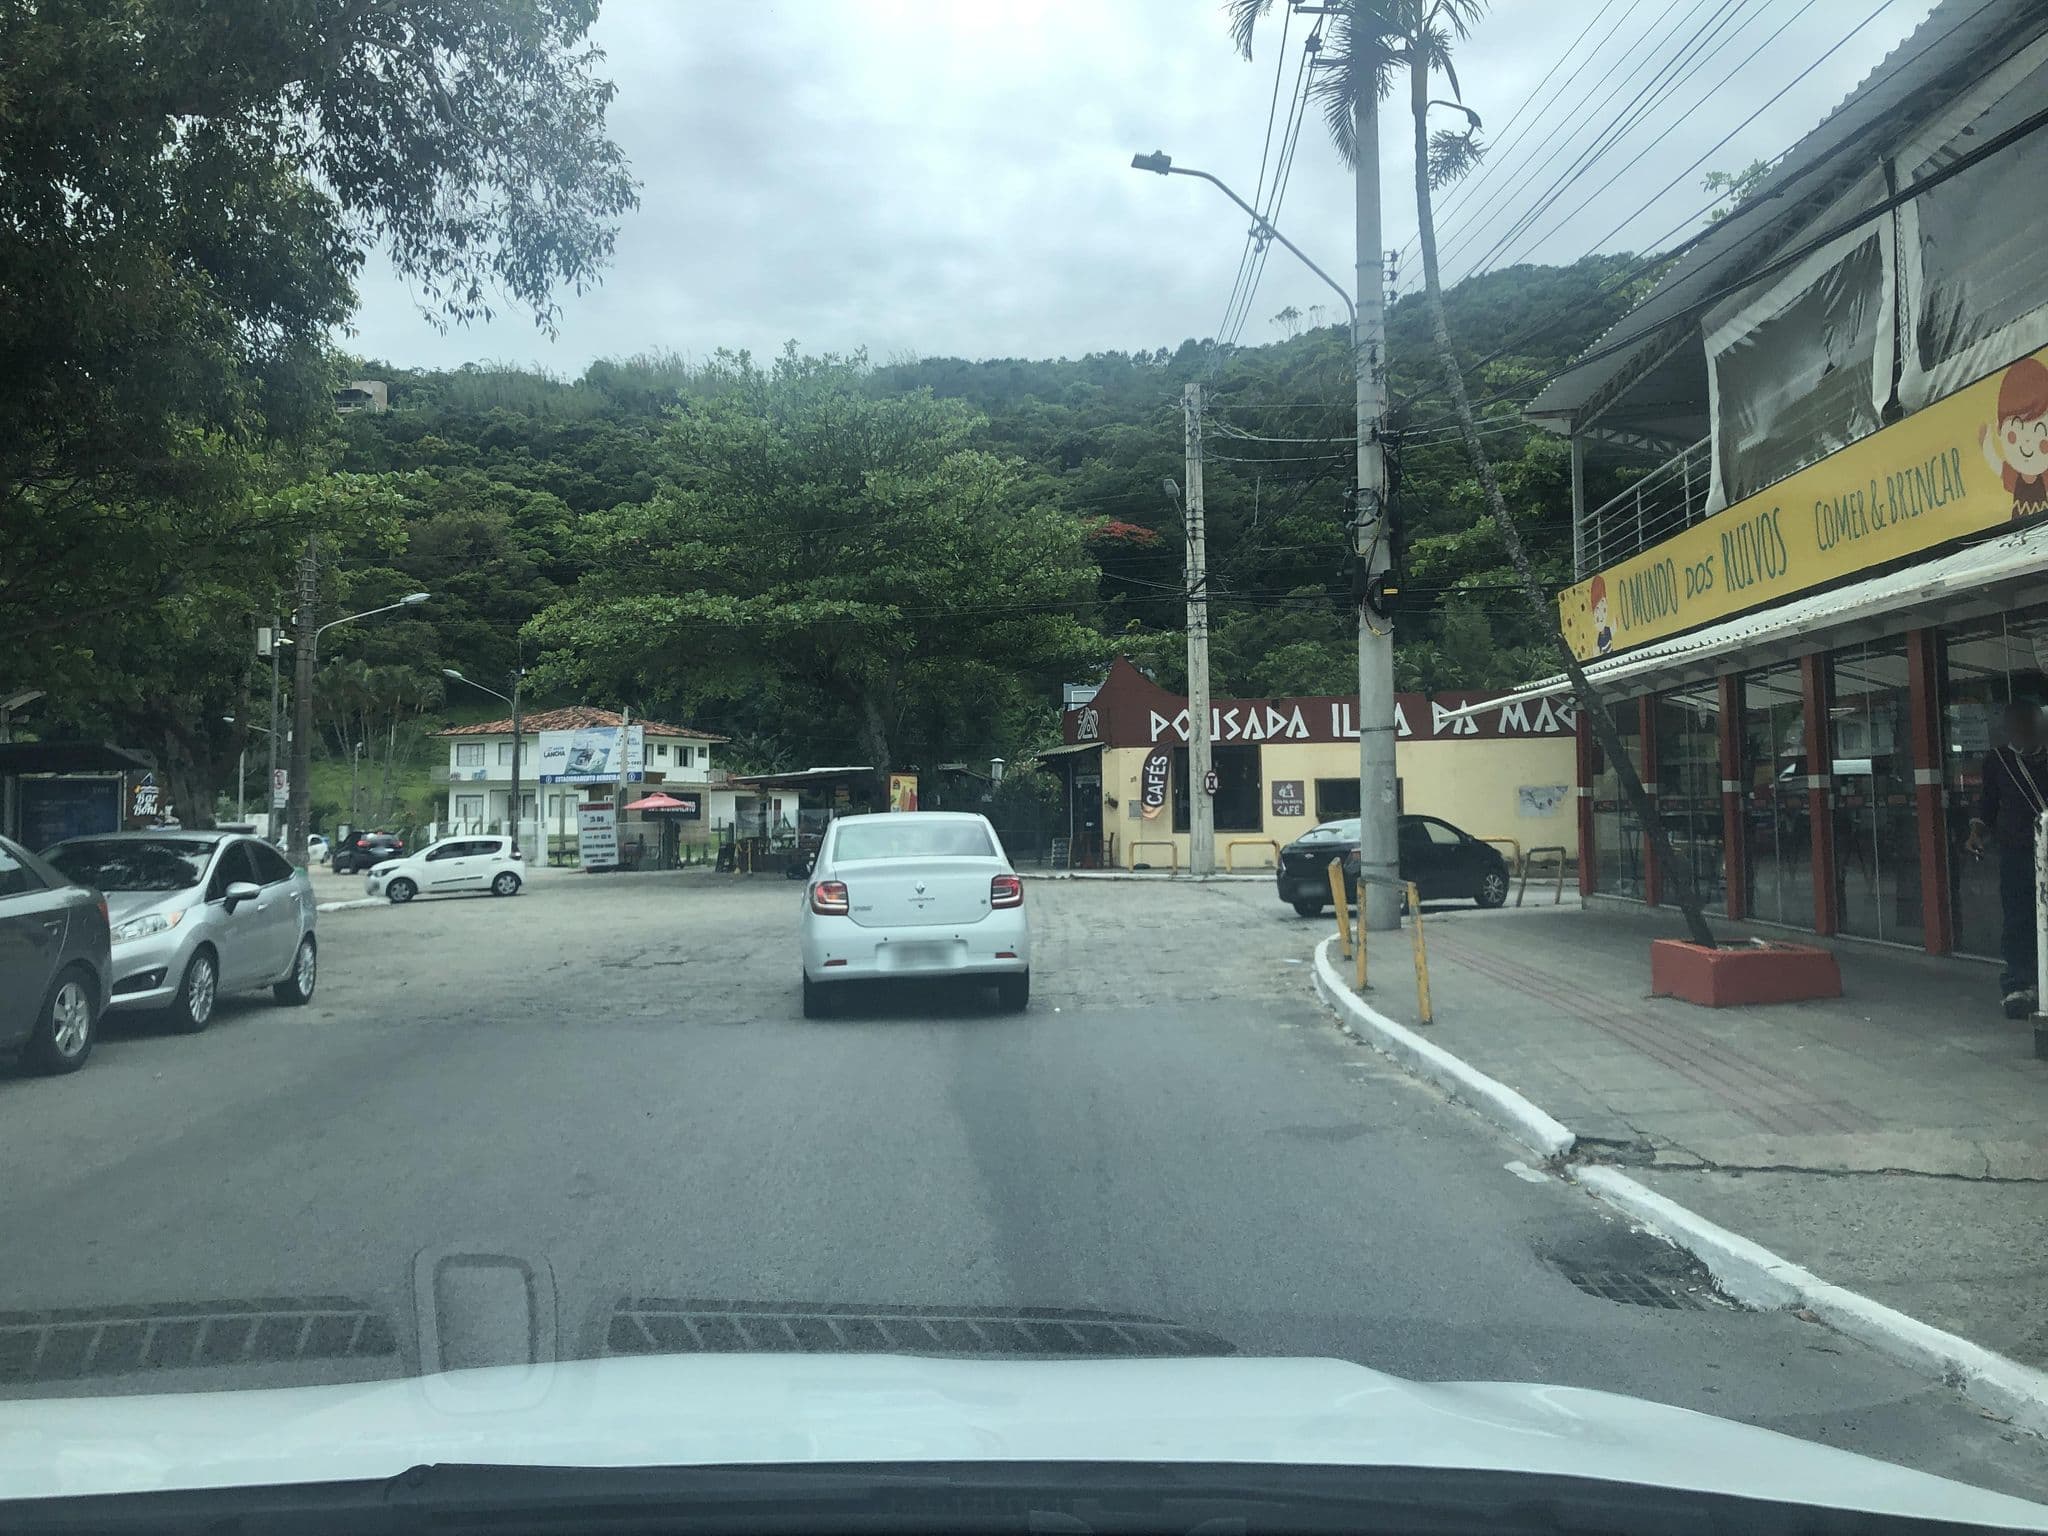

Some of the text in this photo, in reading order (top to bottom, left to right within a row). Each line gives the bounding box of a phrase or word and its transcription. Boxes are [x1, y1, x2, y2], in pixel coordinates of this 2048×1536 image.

[1815, 447, 1966, 551] COMER & BRINCAR
[1619, 507, 1788, 631] O MUNDO DOS RUIVOS
[1331, 702, 1413, 737] ILA
[1431, 699, 1479, 735] DA
[1146, 756, 1168, 806] CAFÉS
